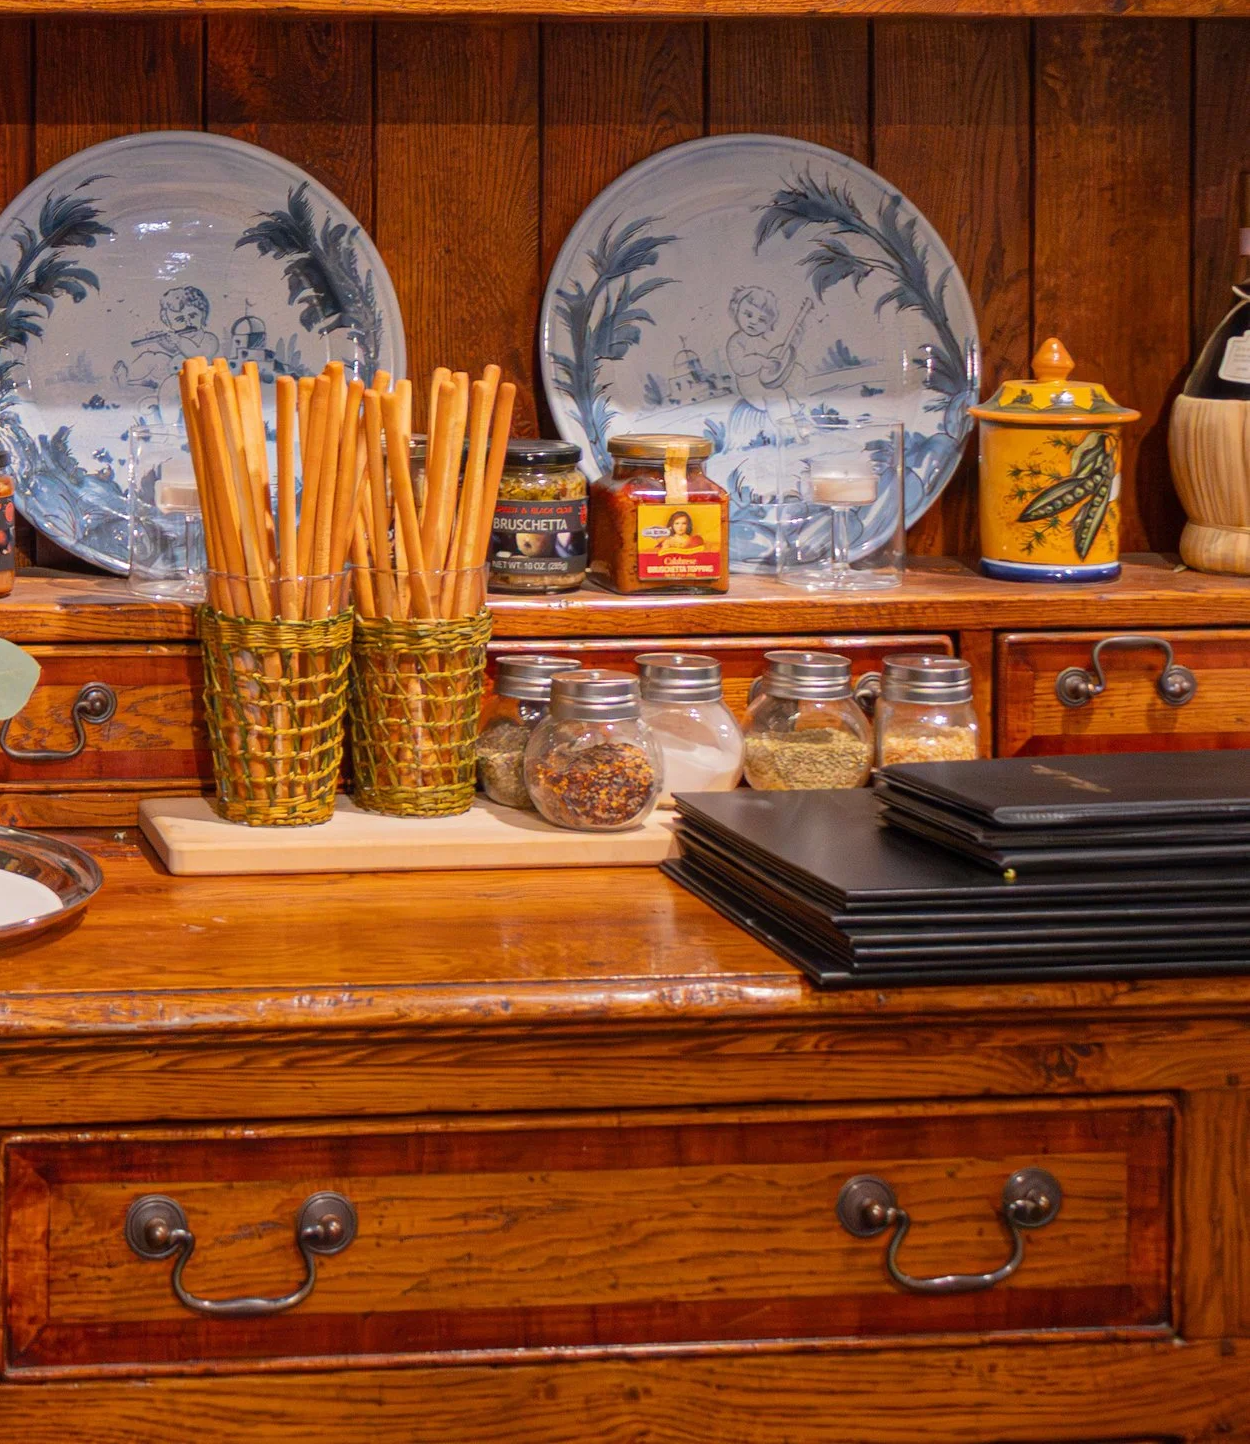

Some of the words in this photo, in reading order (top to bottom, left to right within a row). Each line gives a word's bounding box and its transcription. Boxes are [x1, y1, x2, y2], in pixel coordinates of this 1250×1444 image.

[493, 517, 568, 531] BRUSCHETTA
[492, 561, 507, 569] NET
[524, 561, 533, 569] 10
